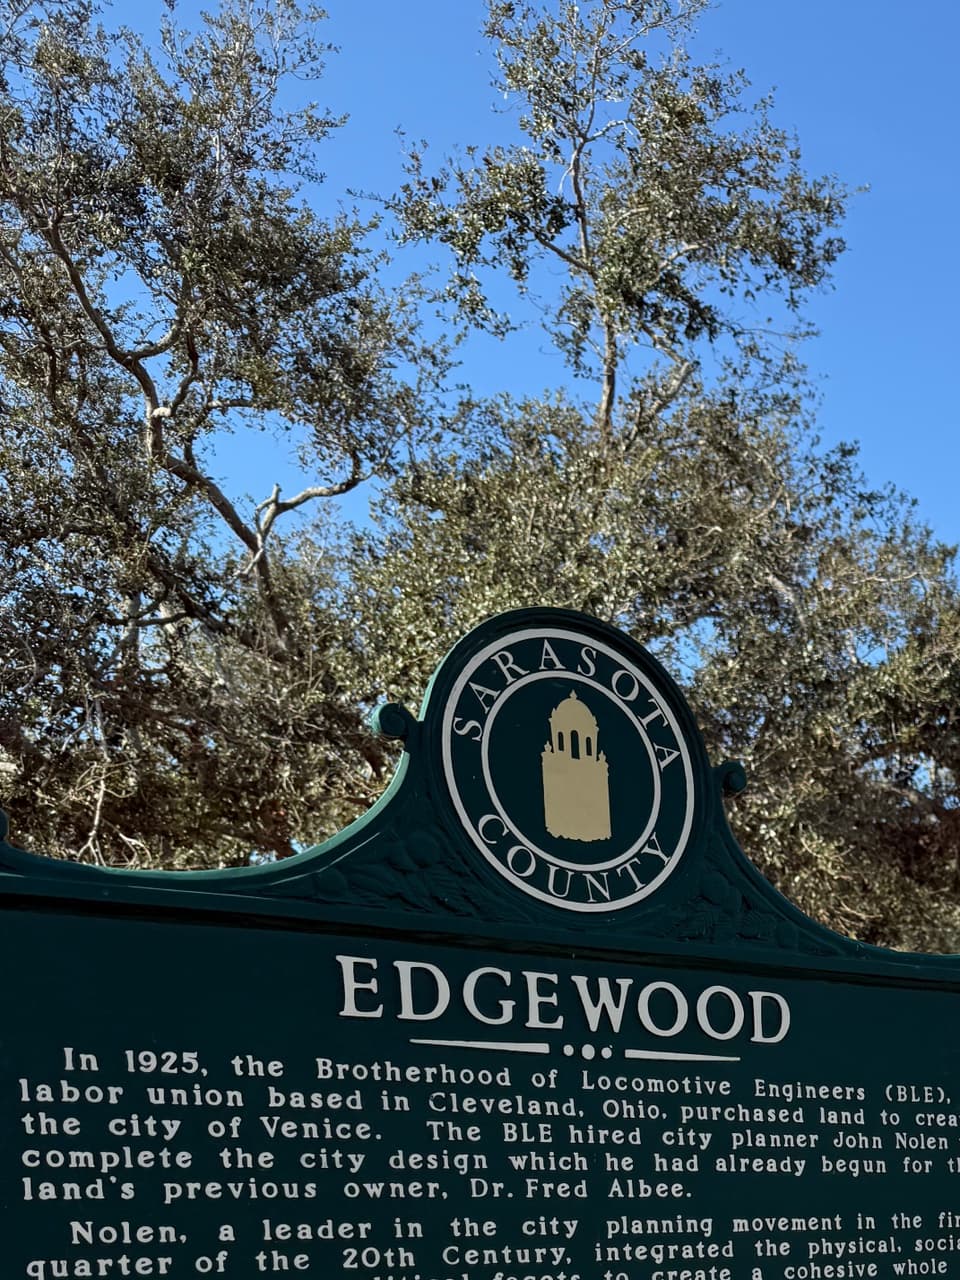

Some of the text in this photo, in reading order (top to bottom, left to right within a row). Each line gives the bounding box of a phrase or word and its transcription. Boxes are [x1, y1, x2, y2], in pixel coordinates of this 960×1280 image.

[452, 638, 681, 771] SARASOTA
[476, 812, 672, 904] COUNTY
[335, 954, 791, 1044] EDGEWOOD
[63, 1047, 99, 1071] In
[124, 1049, 208, 1077] 1925,
[230, 1054, 284, 1077] the
[315, 1057, 512, 1087] Brotherhood
[531, 1068, 559, 1089] of
[581, 1070, 731, 1096] Locomotive
[754, 1078, 865, 1103] Engineers
[885, 1084, 951, 1105] (BLE),
[18, 1078, 124, 1105] labor
[146, 1083, 244, 1107] union
[267, 1086, 363, 1110] based
[380, 1089, 410, 1111] in
[428, 1091, 584, 1118] Cleveland,
[602, 1099, 667, 1120] Ohio,
[680, 1103, 804, 1124] purchased
[819, 1106, 865, 1125] land
[879, 1109, 900, 1126] to
[21, 1111, 81, 1136] the
[108, 1113, 182, 1141] city
[207, 1116, 242, 1138] of
[259, 1116, 382, 1140] Venice.
[426, 1120, 481, 1142] The
[502, 1122, 553, 1143] BLE
[568, 1124, 642, 1145] hired
[662, 1127, 713, 1151] city
[731, 1129, 819, 1150] planner
[833, 1131, 883, 1149] John
[894, 1132, 949, 1150] Nolen
[21, 1175, 692, 1205] land's previous owner, Dr. Fred Albee.
[69, 1221, 187, 1245] Nolen,
[218, 1224, 236, 1242] a
[262, 1219, 372, 1241] leader
[393, 1217, 424, 1238] in
[449, 1217, 497, 1237] the
[522, 1215, 579, 1239] city
[606, 1214, 713, 1239] planning
[732, 1213, 842, 1233] movement
[857, 1212, 876, 1230] in
[891, 1212, 922, 1230] the
[195, 1250, 228, 1273] of
[255, 1250, 310, 1272] the
[342, 1246, 416, 1269] 20th
[442, 1245, 572, 1266] Century,
[594, 1240, 734, 1265] integrated
[754, 1238, 791, 1257] the
[807, 1236, 902, 1259] physical,
